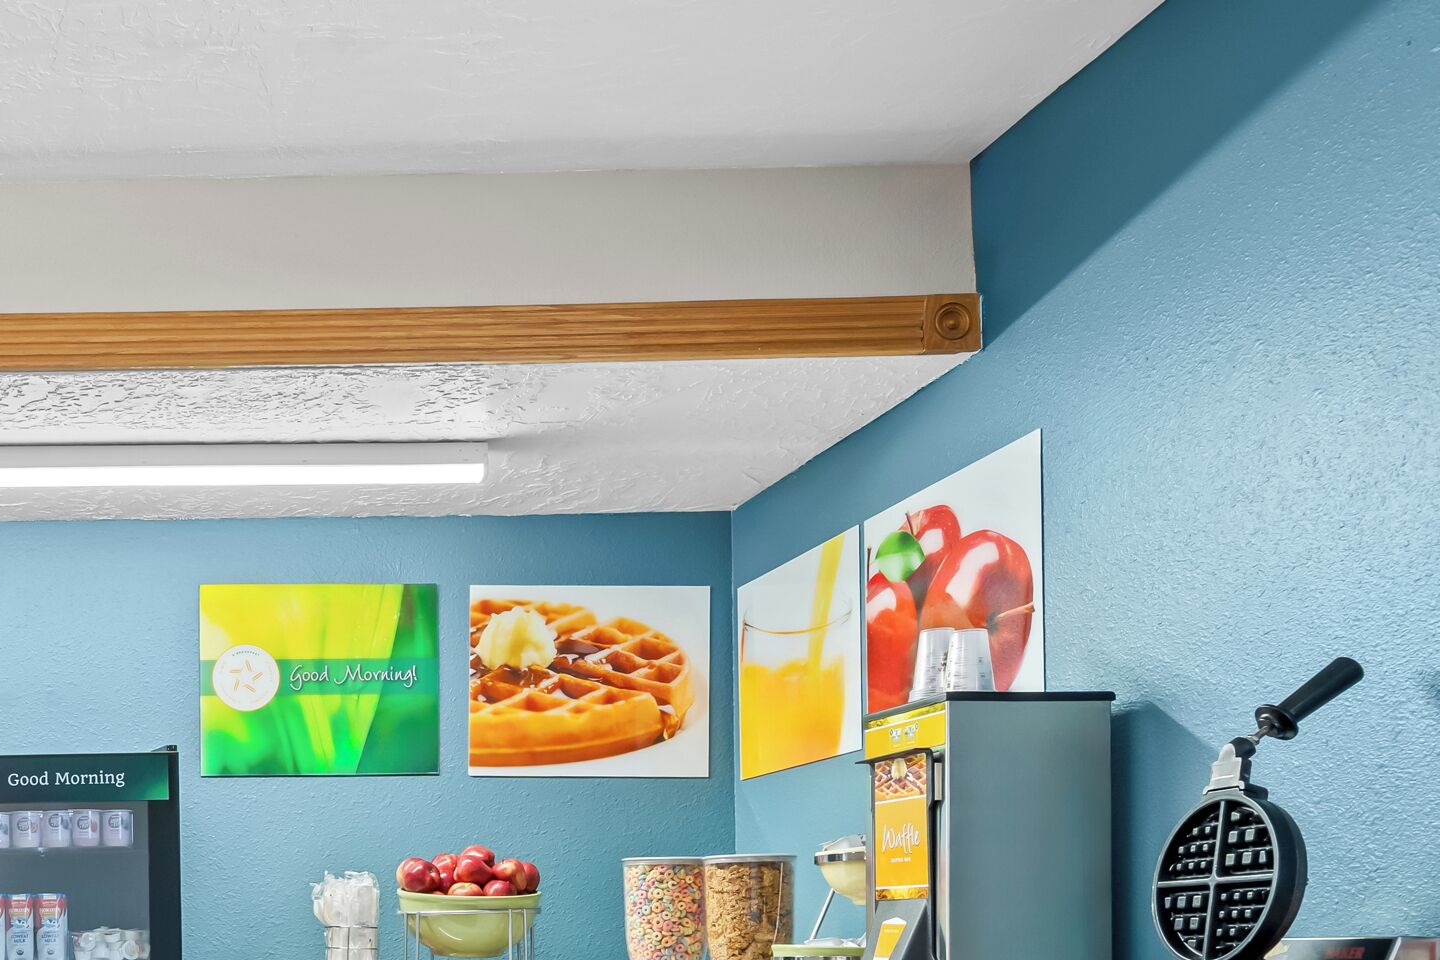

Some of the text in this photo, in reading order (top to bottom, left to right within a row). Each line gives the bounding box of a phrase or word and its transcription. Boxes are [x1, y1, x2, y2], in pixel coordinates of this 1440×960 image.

[289, 664, 418, 690] Good Morning!
[8, 770, 125, 787] Good Morning
[882, 823, 920, 853] Waffle
